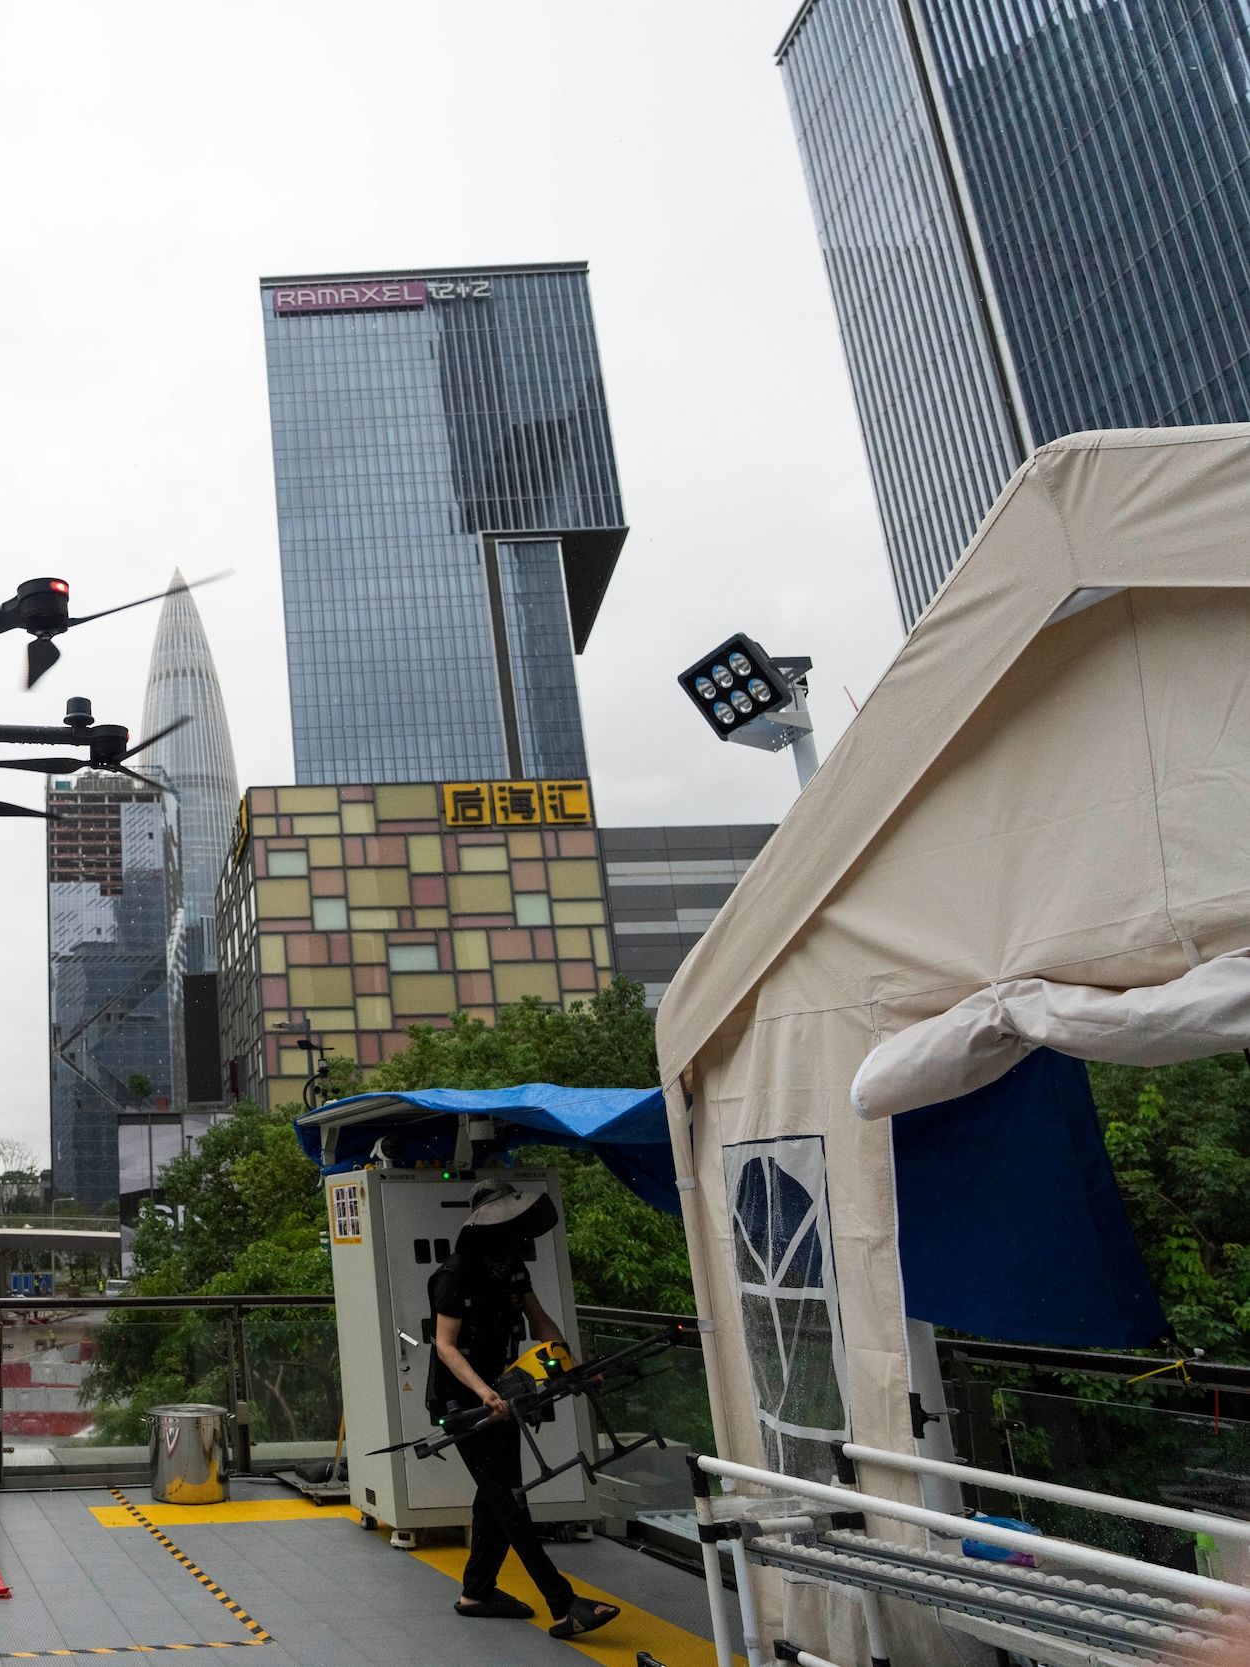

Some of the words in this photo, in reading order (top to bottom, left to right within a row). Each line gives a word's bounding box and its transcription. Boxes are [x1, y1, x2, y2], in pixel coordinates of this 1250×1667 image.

[277, 286, 423, 307] RAMAXEL
[451, 784, 587, 822] 后海汇
